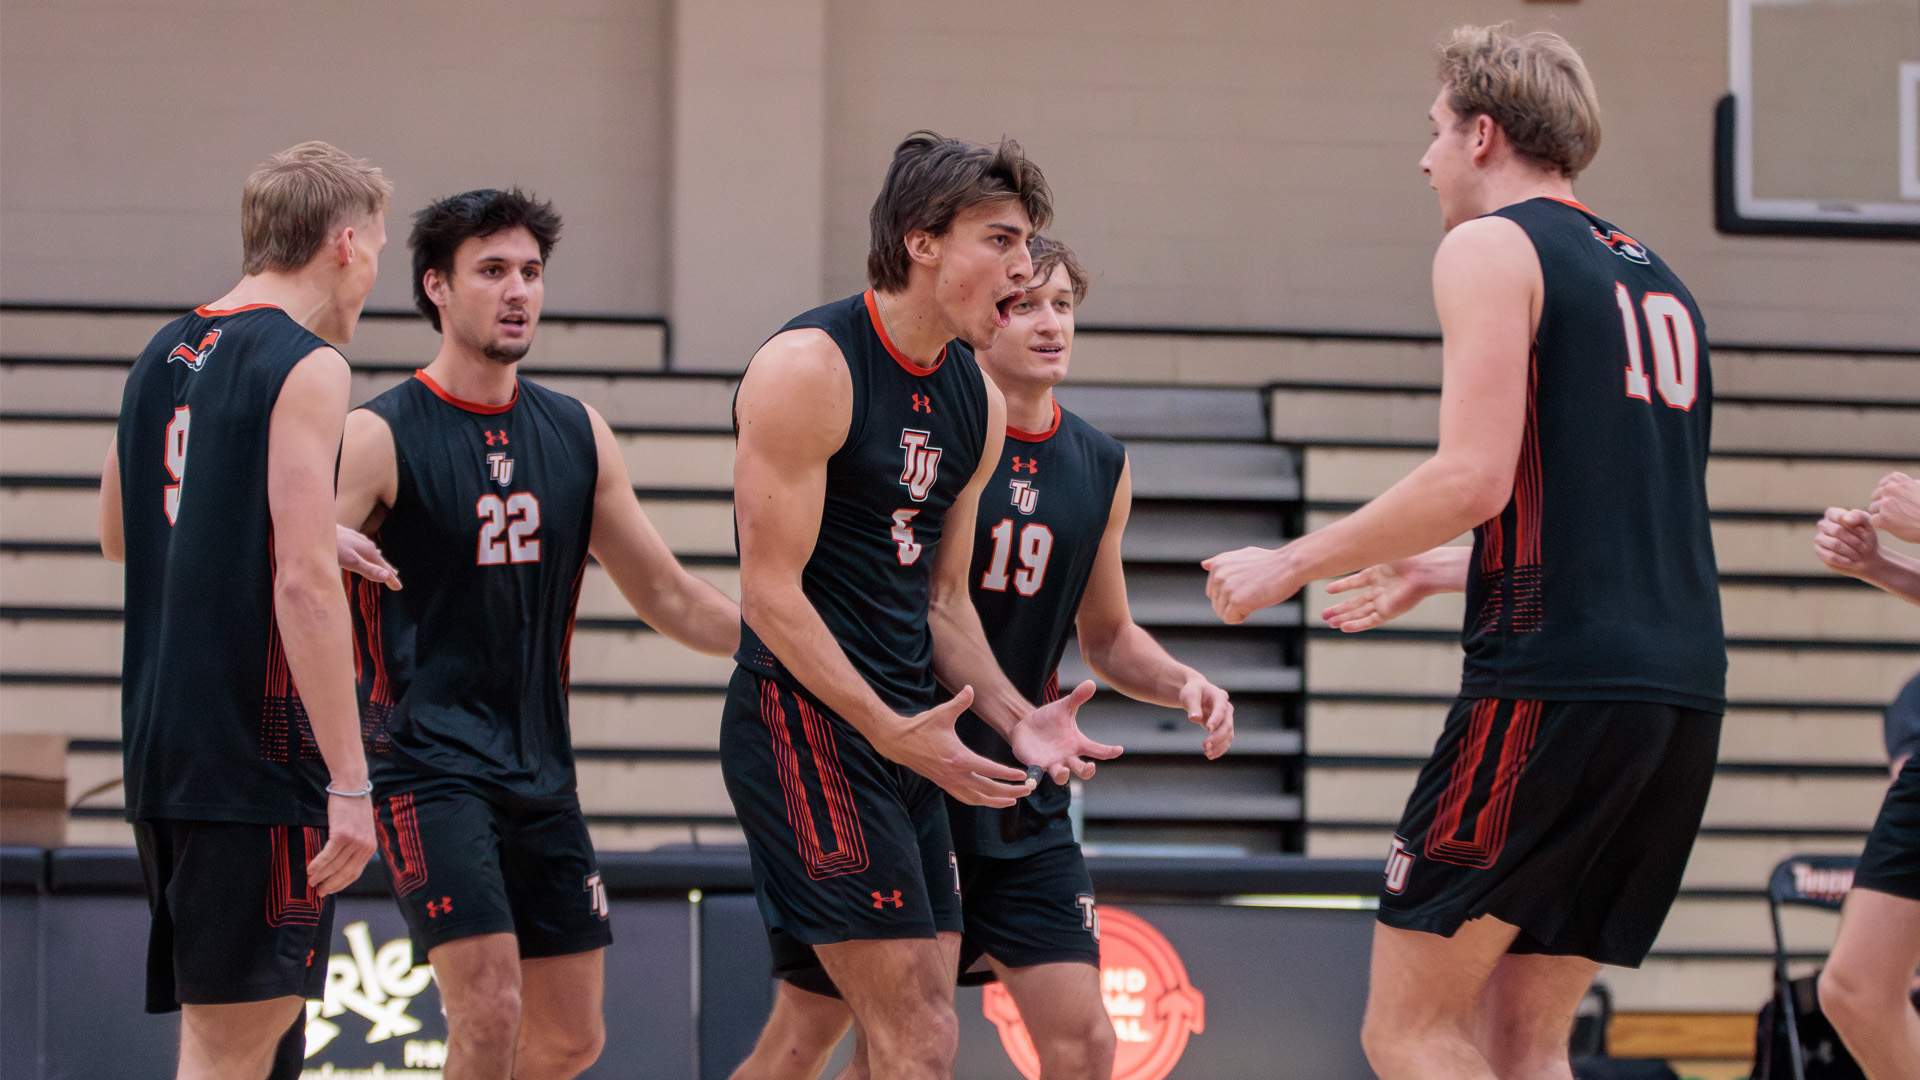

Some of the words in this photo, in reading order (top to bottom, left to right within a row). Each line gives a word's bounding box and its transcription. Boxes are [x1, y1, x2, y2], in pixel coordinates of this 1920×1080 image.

[1614, 280, 1699, 412] 10
[163, 404, 191, 527] 9
[486, 452, 514, 487] TU
[900, 428, 942, 502] TU
[1009, 479, 1039, 515] TU
[476, 491, 541, 566] 22
[981, 518, 1054, 597] 19
[583, 870, 609, 921] TU
[1384, 833, 1416, 896] TU
